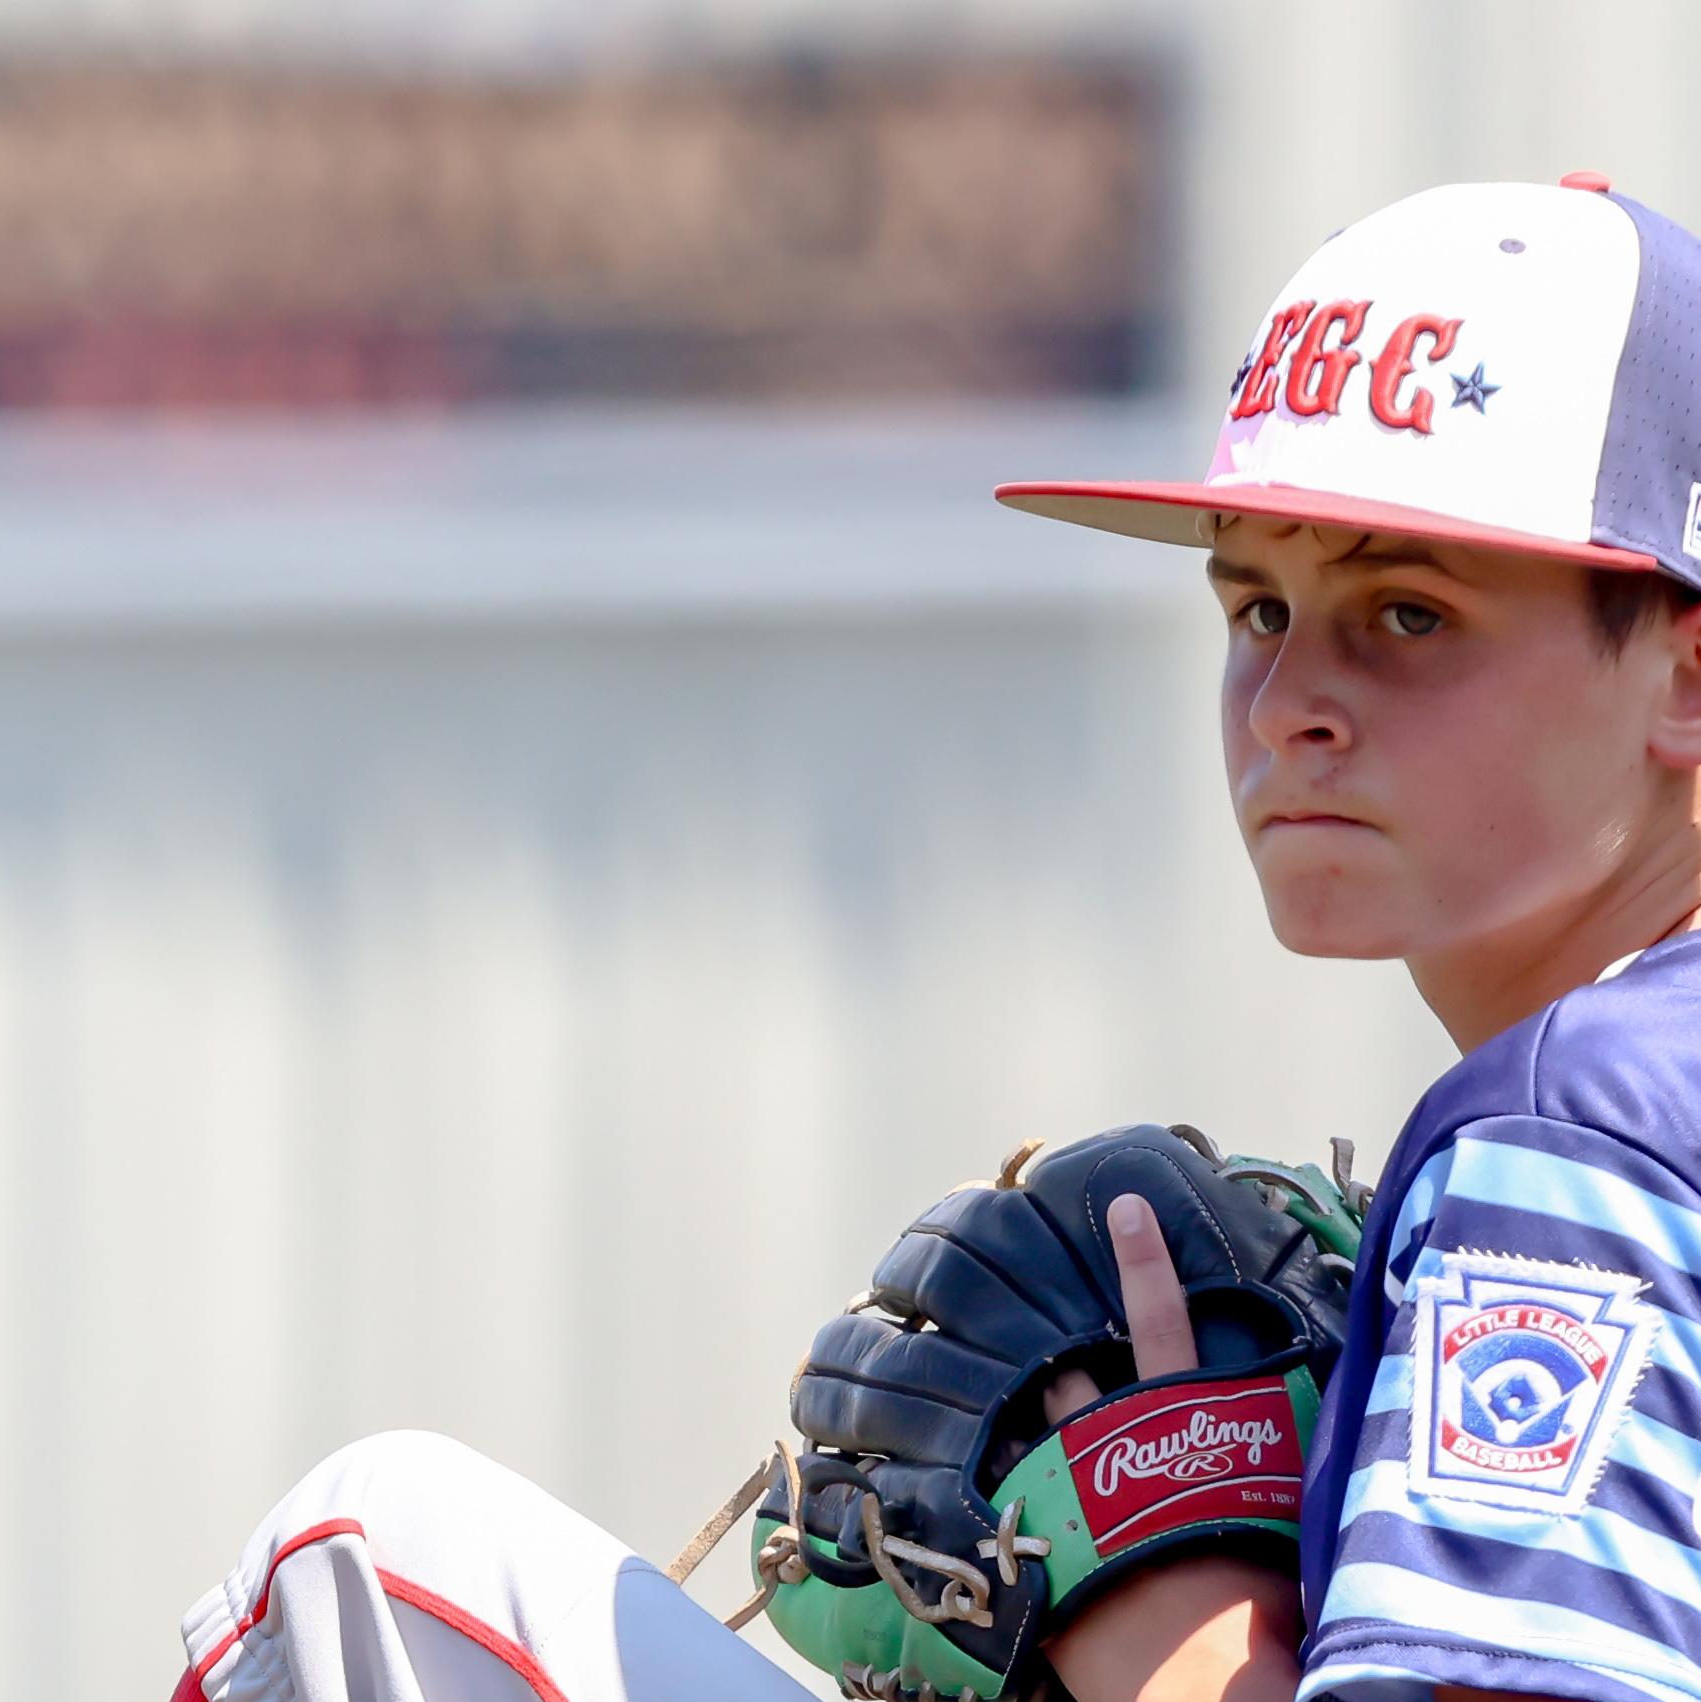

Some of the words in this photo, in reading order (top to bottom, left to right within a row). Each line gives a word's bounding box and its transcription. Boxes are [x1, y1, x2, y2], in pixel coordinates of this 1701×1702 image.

[1229, 299, 1466, 435] EGC
[1452, 1308, 1521, 1347] LITTLE
[1526, 1310, 1602, 1365] LEAGUE
[1094, 1410, 1282, 1497] Rawlings
[1451, 1436, 1564, 1471] BASEBALL
[1240, 1490, 1267, 1502] Est.
